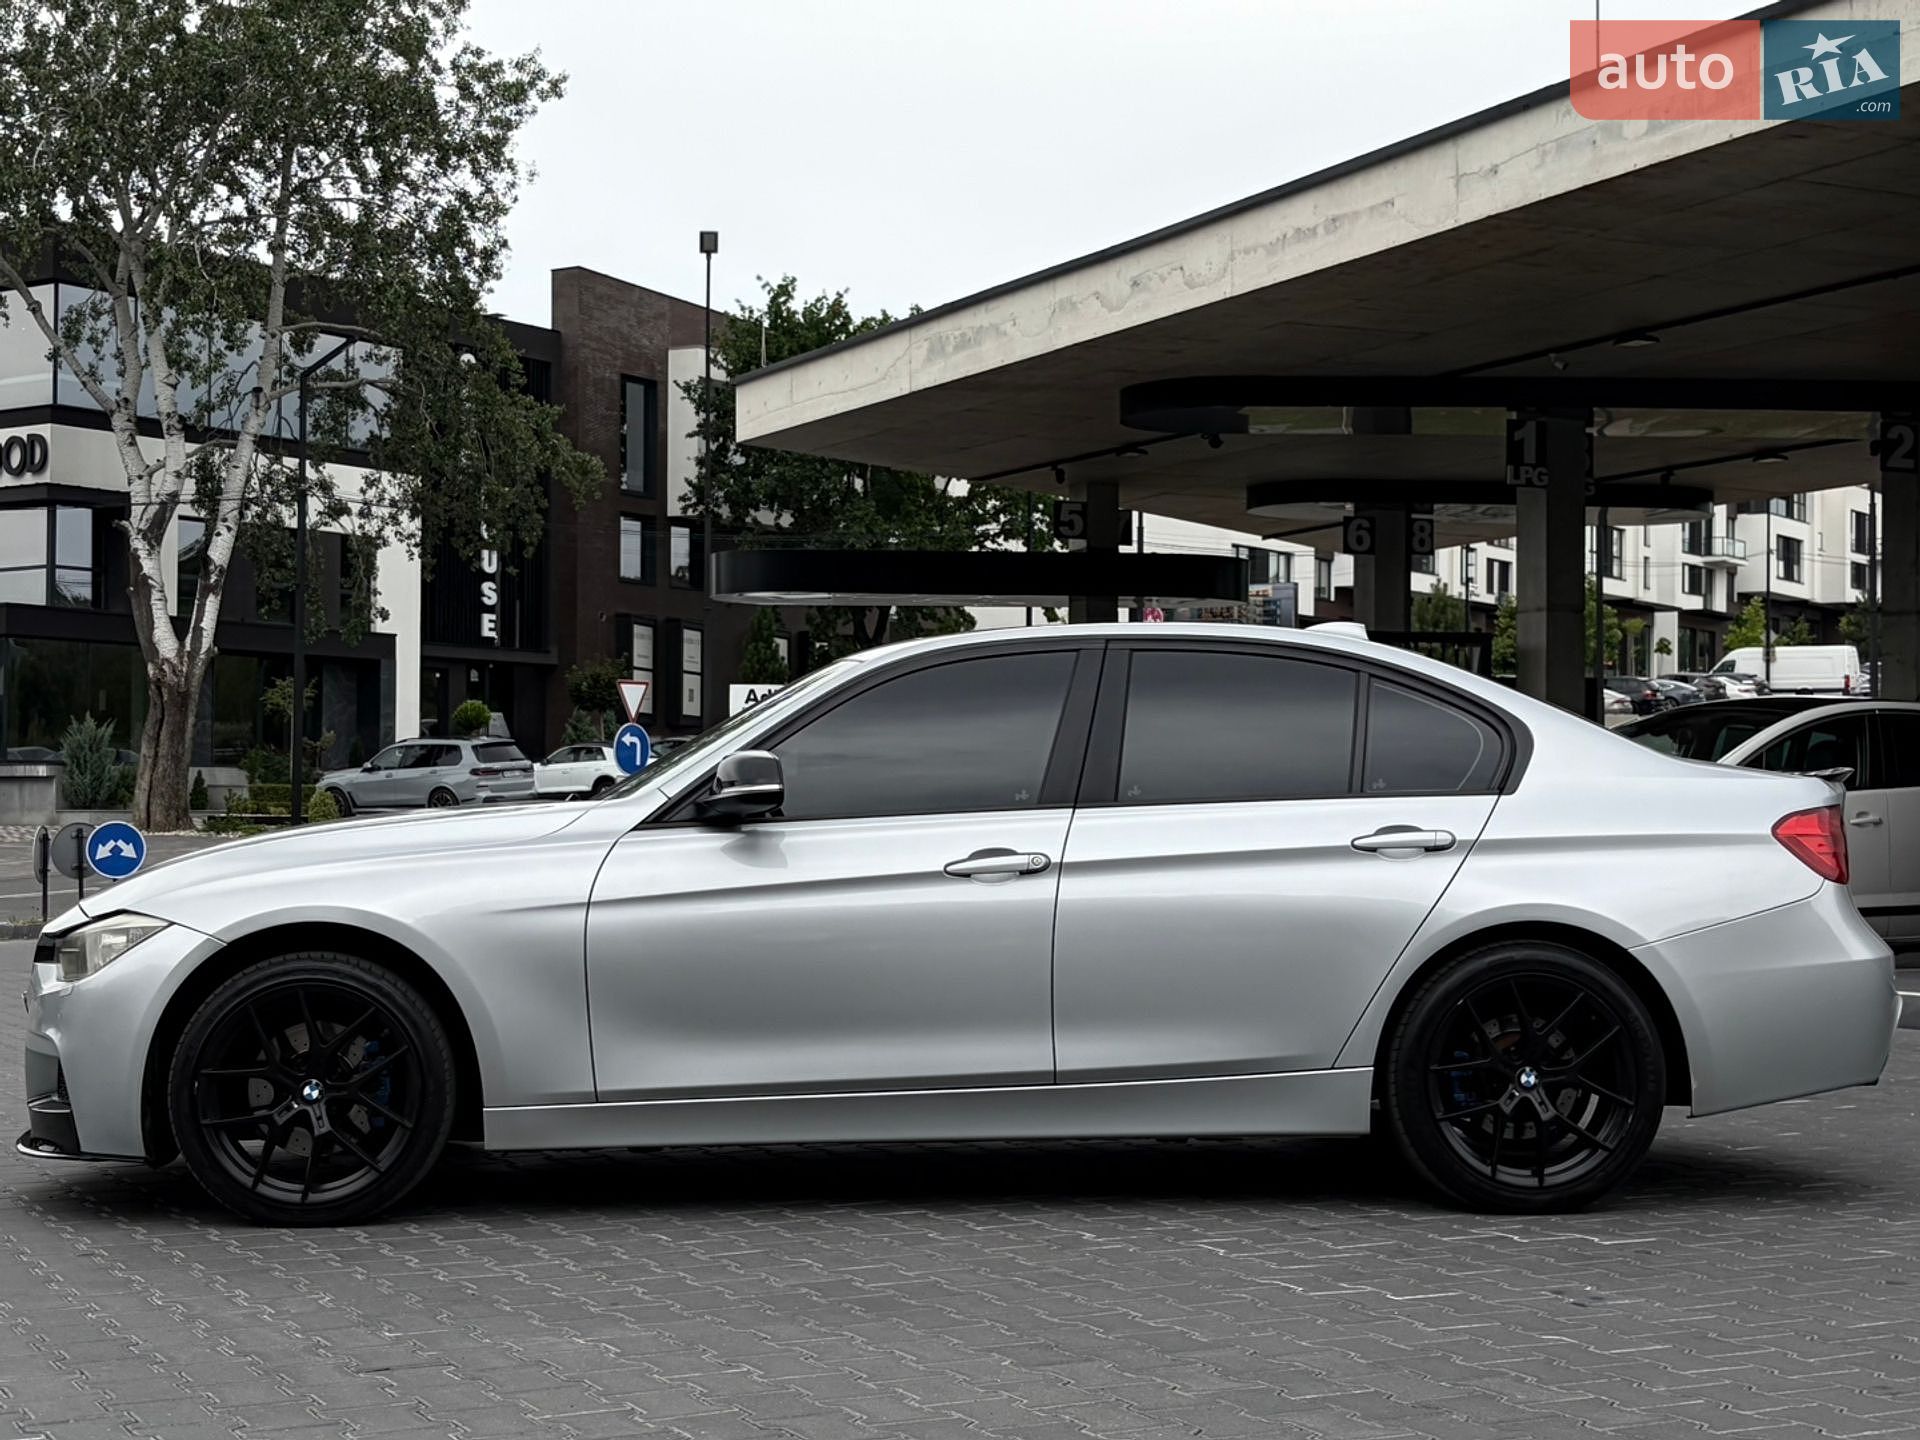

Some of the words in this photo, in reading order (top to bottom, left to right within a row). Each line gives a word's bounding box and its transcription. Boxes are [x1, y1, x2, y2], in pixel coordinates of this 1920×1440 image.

[0, 434, 47, 476] OD
[1513, 420, 1537, 464] 1
[1886, 424, 1915, 469] 2
[1506, 465, 1550, 487] LPG
[1058, 503, 1084, 538] 5
[1346, 517, 1372, 553] 6
[1411, 520, 1433, 554] 8
